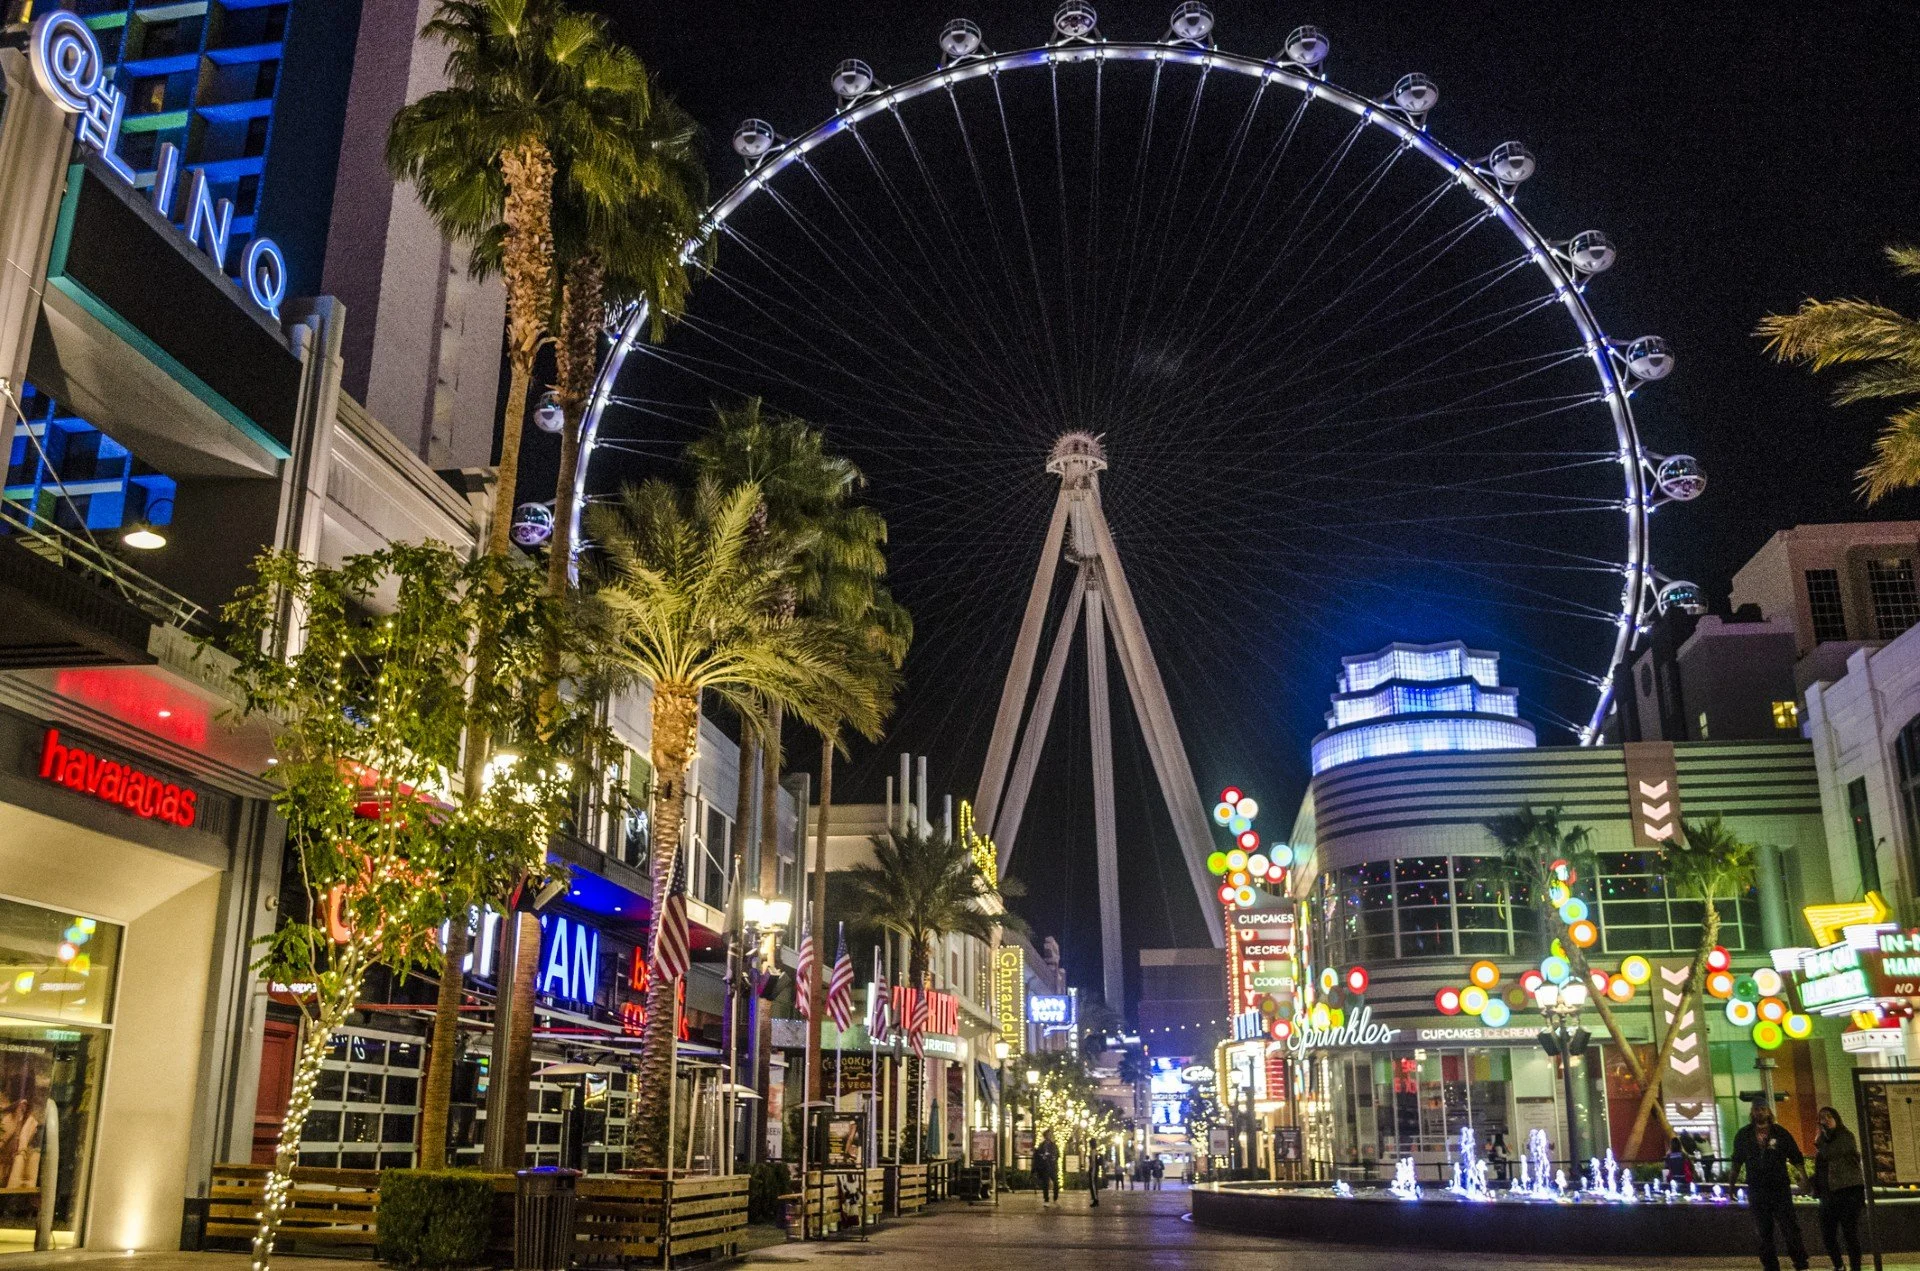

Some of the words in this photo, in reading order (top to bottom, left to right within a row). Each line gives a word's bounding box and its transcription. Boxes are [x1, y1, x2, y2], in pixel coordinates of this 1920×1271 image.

[32, 10, 103, 113] @
[102, 90, 287, 324] LINQ
[39, 728, 198, 828] havaianas
[1238, 913, 1295, 925] CUPCAKES
[1245, 946, 1260, 955] ICE
[1287, 1006, 1400, 1060] Sprinkles
[1421, 1028, 1482, 1040] CUPCAKES
[1484, 1029, 1501, 1038] ICE
[1502, 1028, 1539, 1038] CREAM
